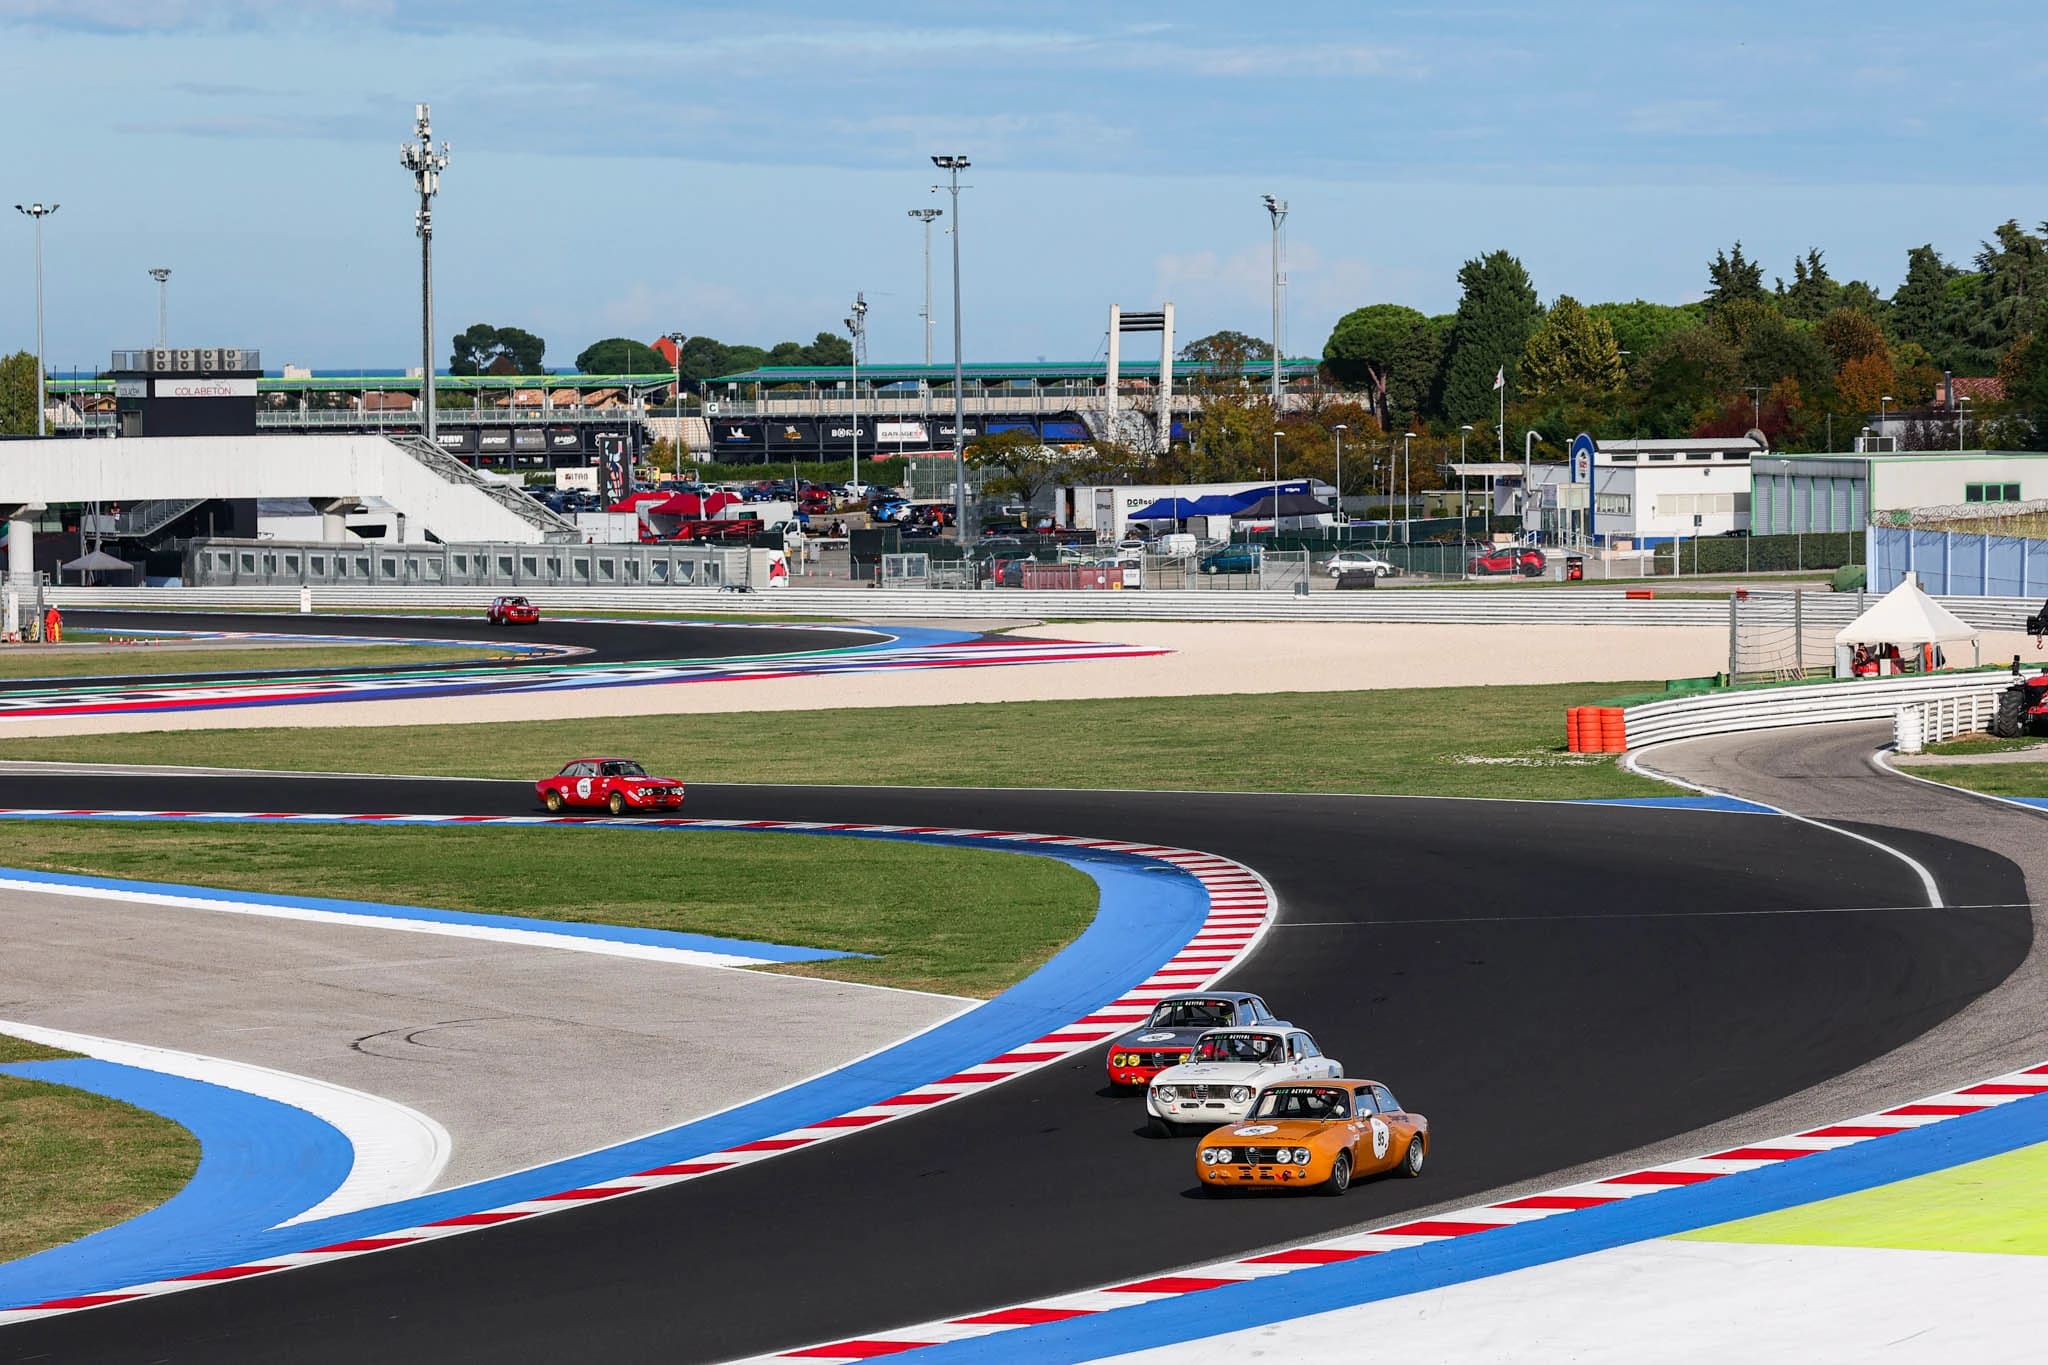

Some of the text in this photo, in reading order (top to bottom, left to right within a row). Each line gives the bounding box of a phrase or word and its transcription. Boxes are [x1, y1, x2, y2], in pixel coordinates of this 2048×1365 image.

[175, 386, 231, 396] COLABETON
[708, 403, 717, 412] C
[831, 428, 864, 437] BORO
[1377, 1131, 1385, 1147] 95
